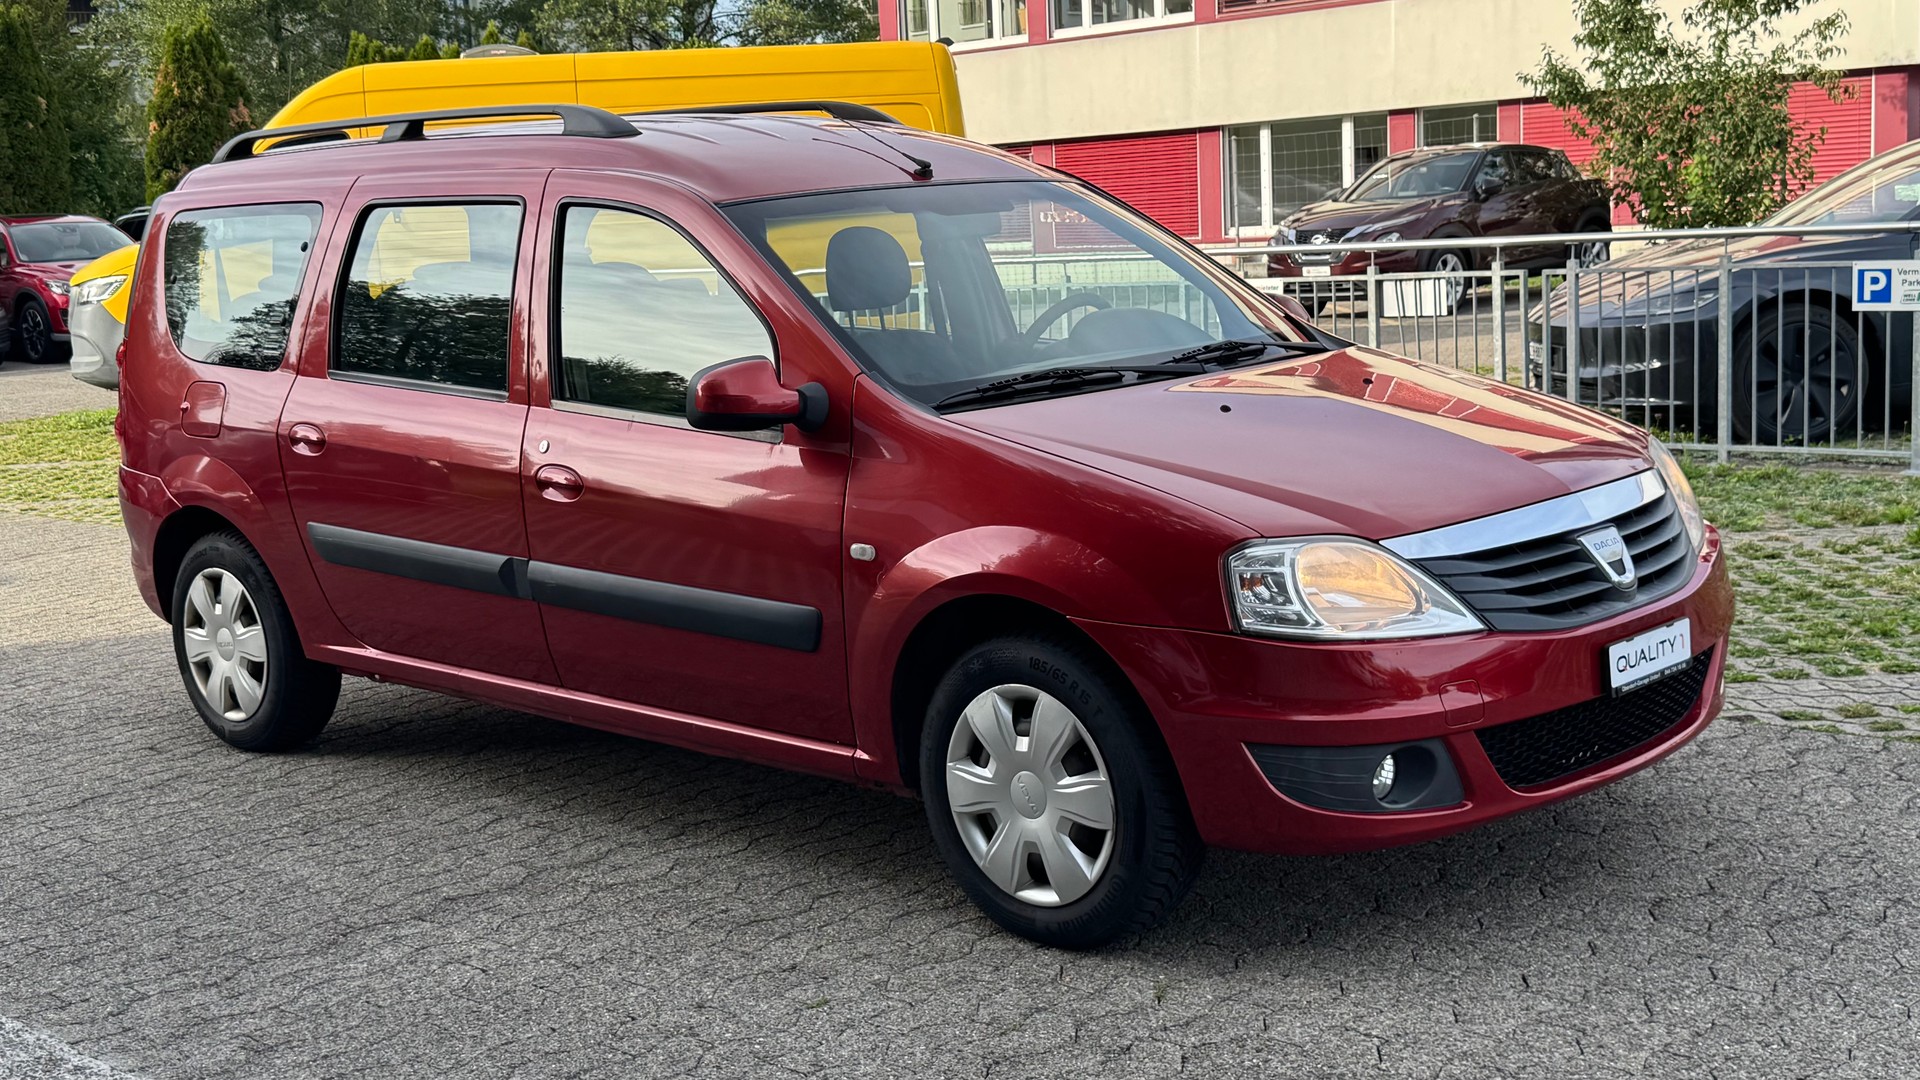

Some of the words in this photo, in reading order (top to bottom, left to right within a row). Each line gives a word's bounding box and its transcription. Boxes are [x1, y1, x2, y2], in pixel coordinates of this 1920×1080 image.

[1863, 271, 1887, 301] P
[1593, 537, 1619, 551] DACIA
[1616, 635, 1676, 673] QUALITY
[1679, 633, 1685, 650] 1
[1028, 656, 1069, 684] 185/65
[1069, 681, 1079, 694] R
[1080, 689, 1092, 704] 15
